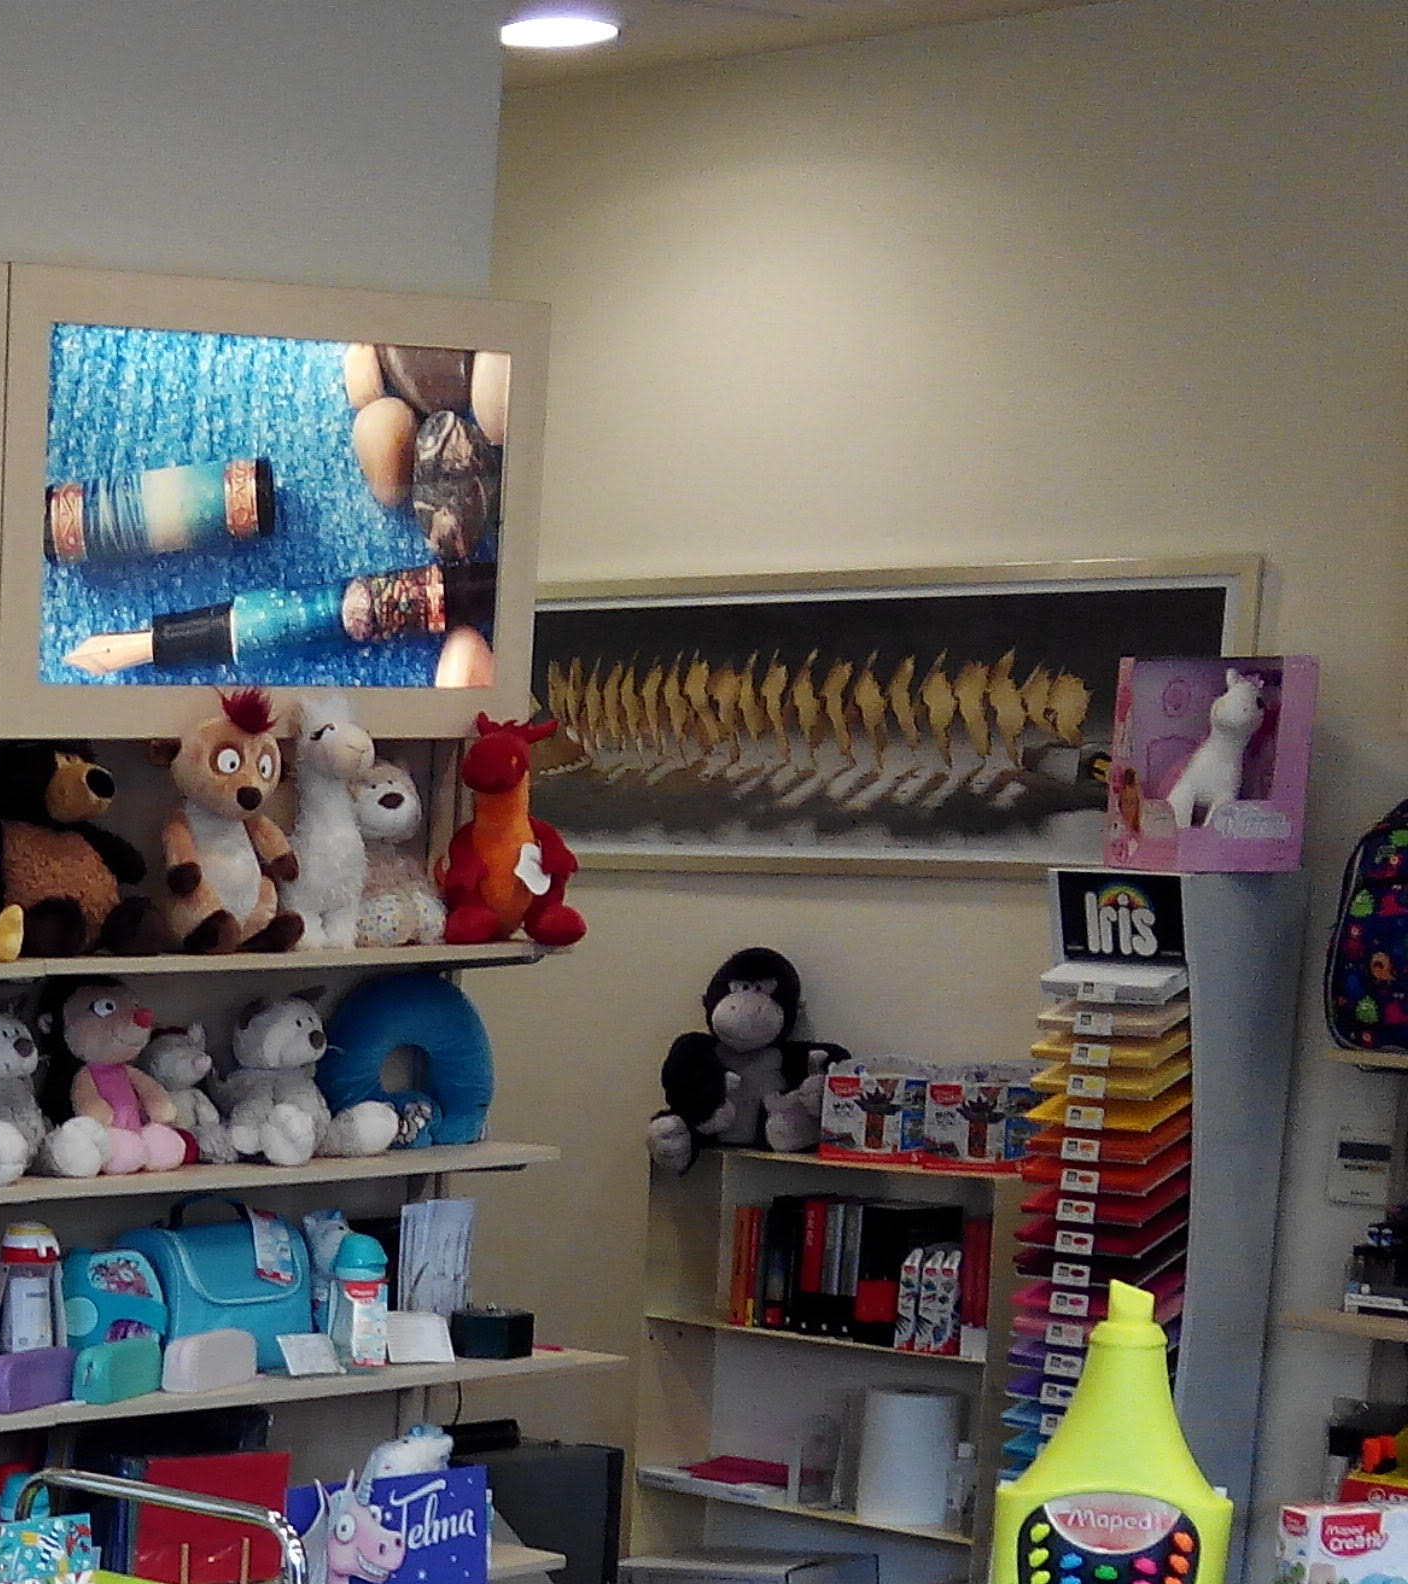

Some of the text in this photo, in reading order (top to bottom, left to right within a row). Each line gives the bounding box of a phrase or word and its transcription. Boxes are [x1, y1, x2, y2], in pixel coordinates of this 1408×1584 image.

[1085, 890, 1159, 957] Iris
[389, 1479, 477, 1550] Telma
[1067, 1509, 1153, 1533] Maped
